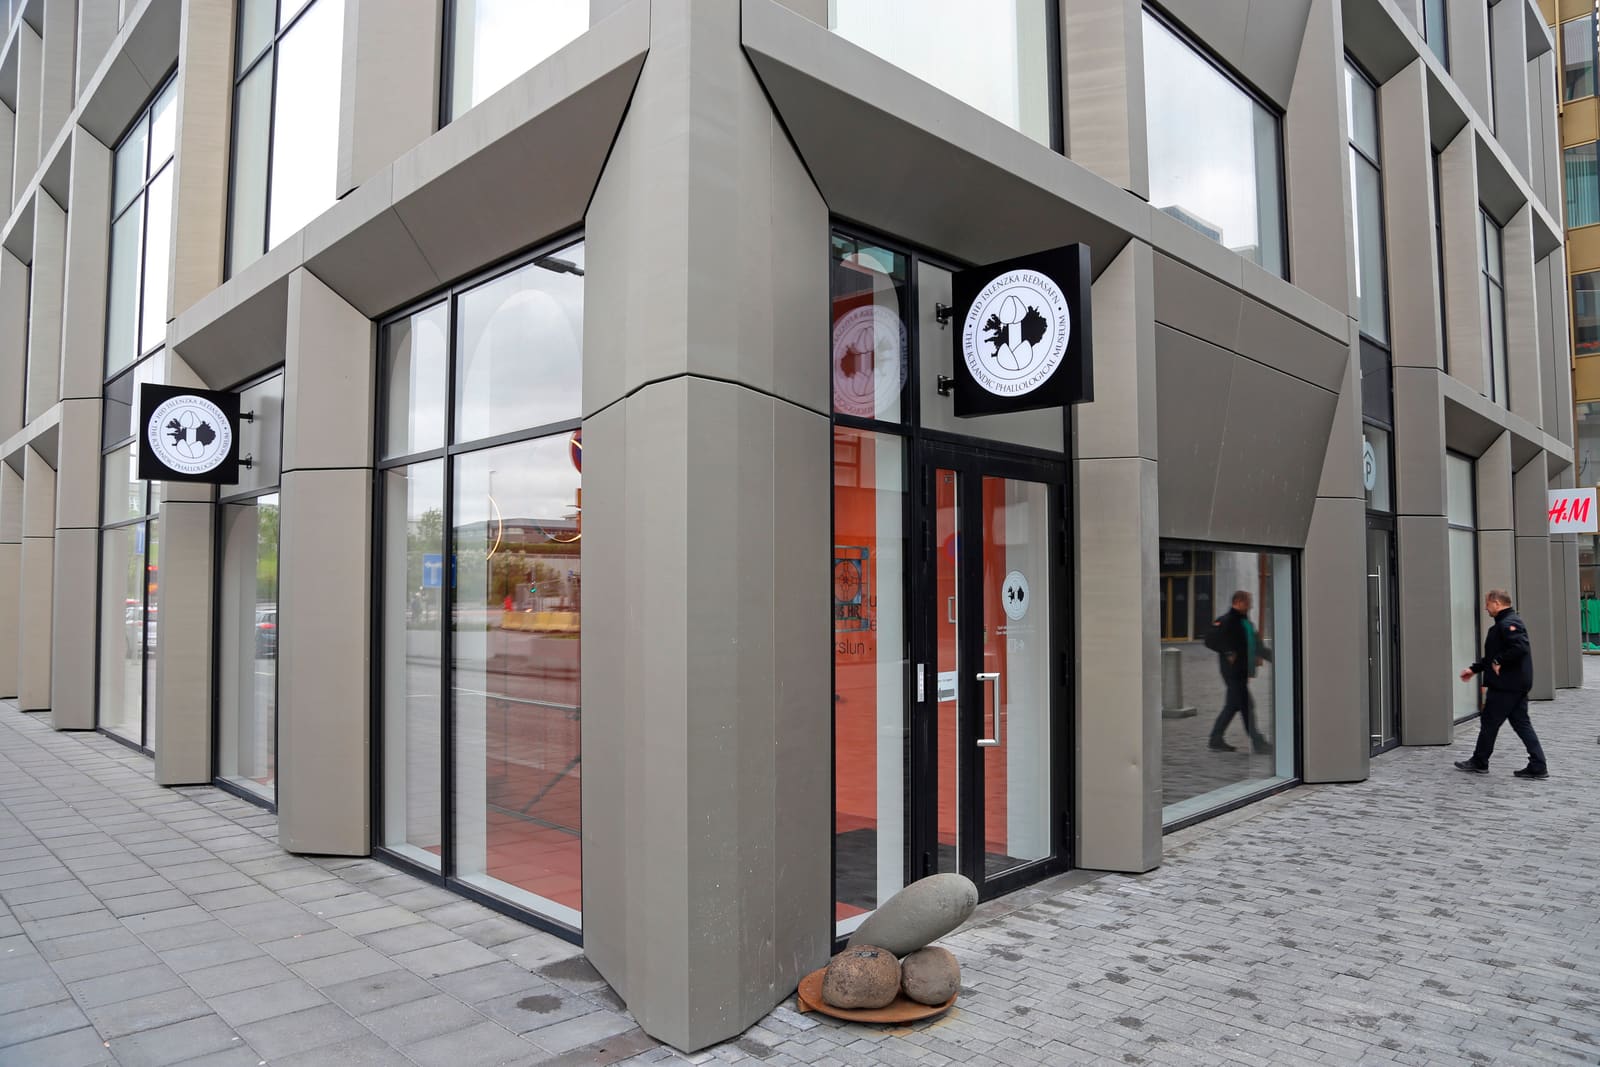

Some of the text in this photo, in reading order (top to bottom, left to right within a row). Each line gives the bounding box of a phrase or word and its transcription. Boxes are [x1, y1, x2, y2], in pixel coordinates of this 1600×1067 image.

[967, 350, 994, 388] ICELANDIC
[995, 359, 1056, 393] PHALLOLOGICAL
[1054, 314, 1067, 358] MUSEUM
[1366, 461, 1372, 482] P
[1548, 497, 1591, 525] H&M
